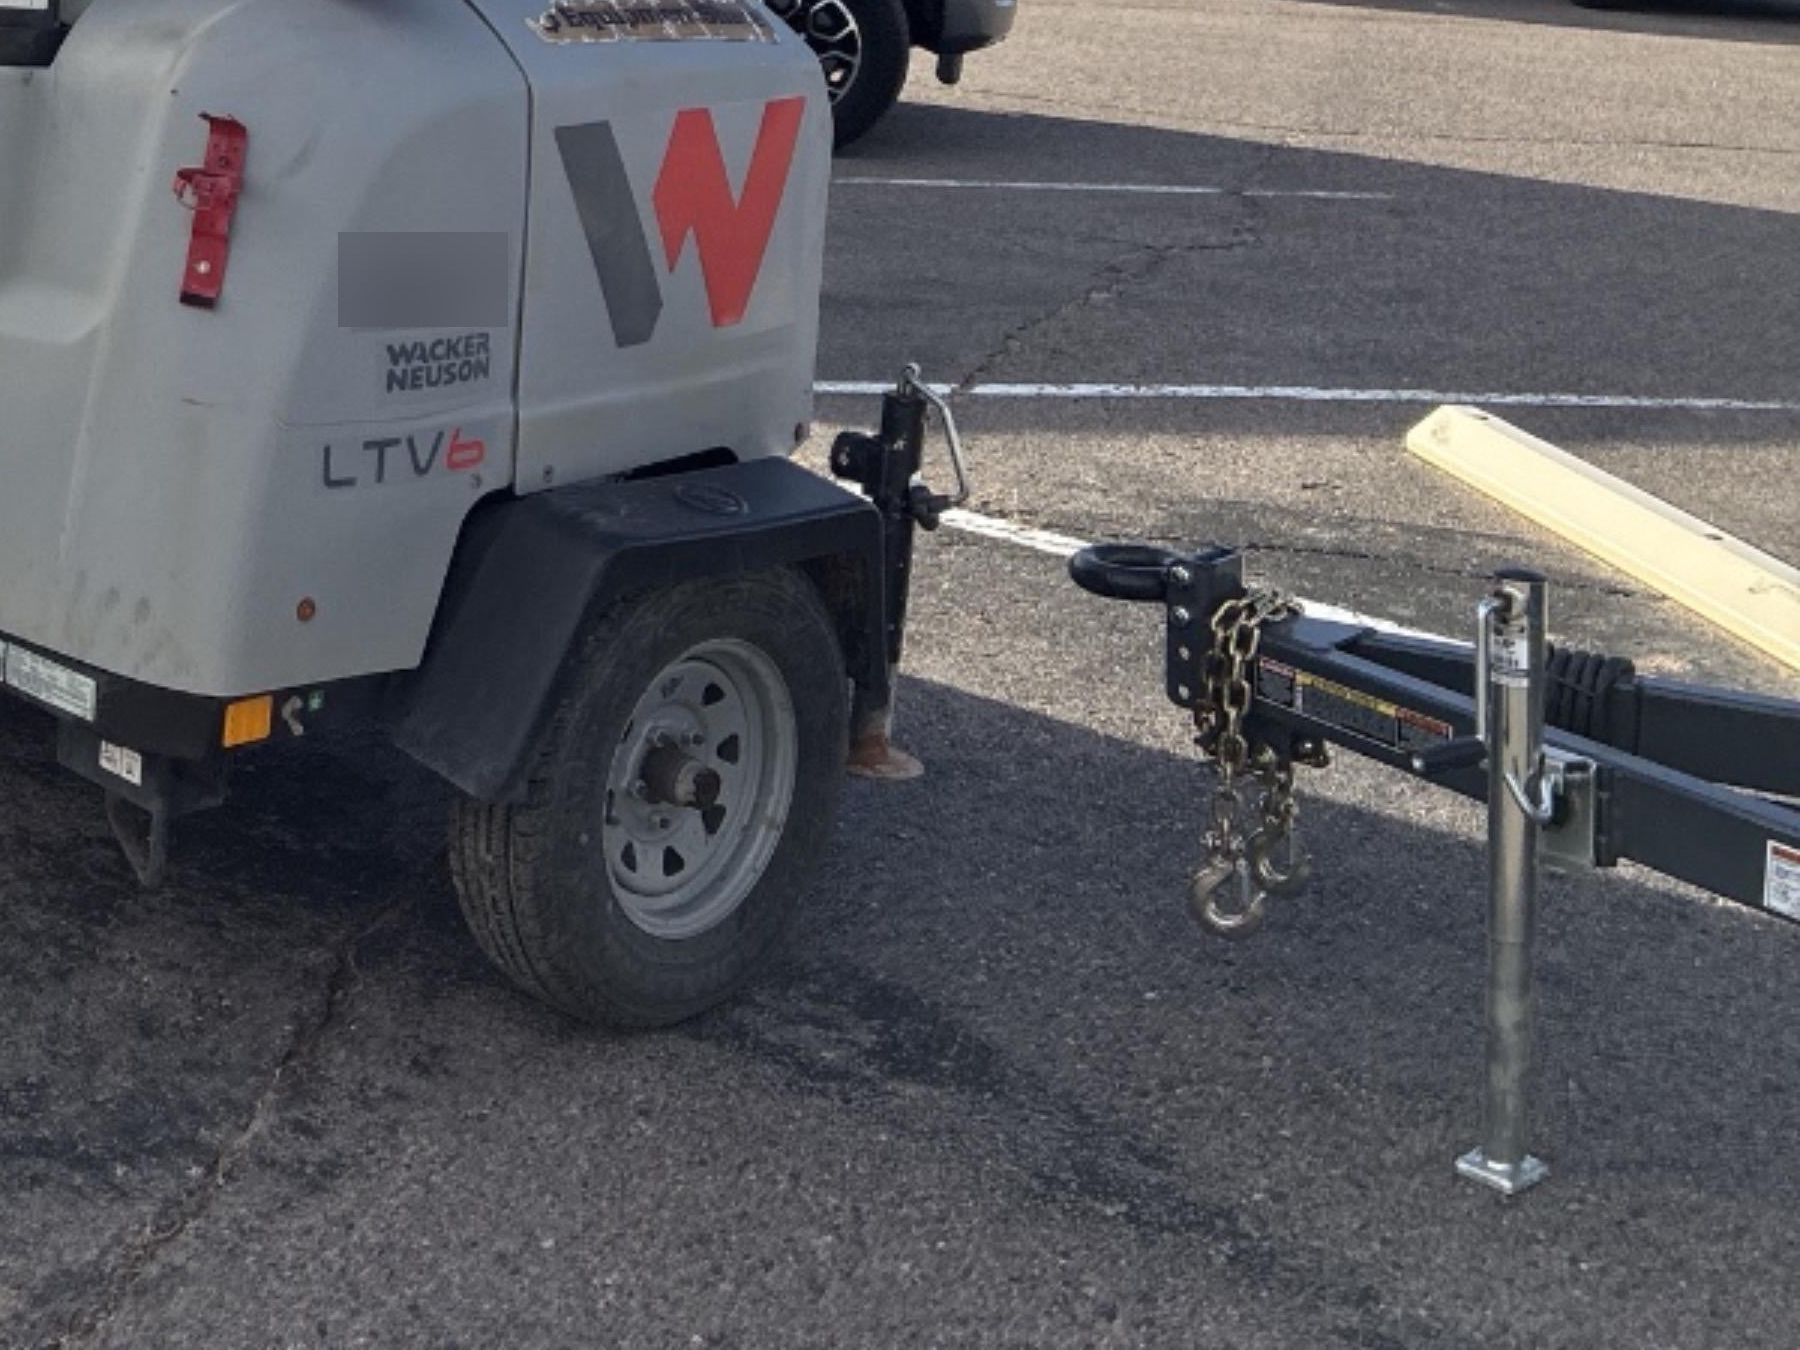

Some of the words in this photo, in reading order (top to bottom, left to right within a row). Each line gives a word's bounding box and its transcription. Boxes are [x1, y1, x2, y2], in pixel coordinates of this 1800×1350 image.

[386, 332, 490, 366] WACKER
[386, 356, 490, 394] NEUSON
[323, 427, 486, 489] LTV6
